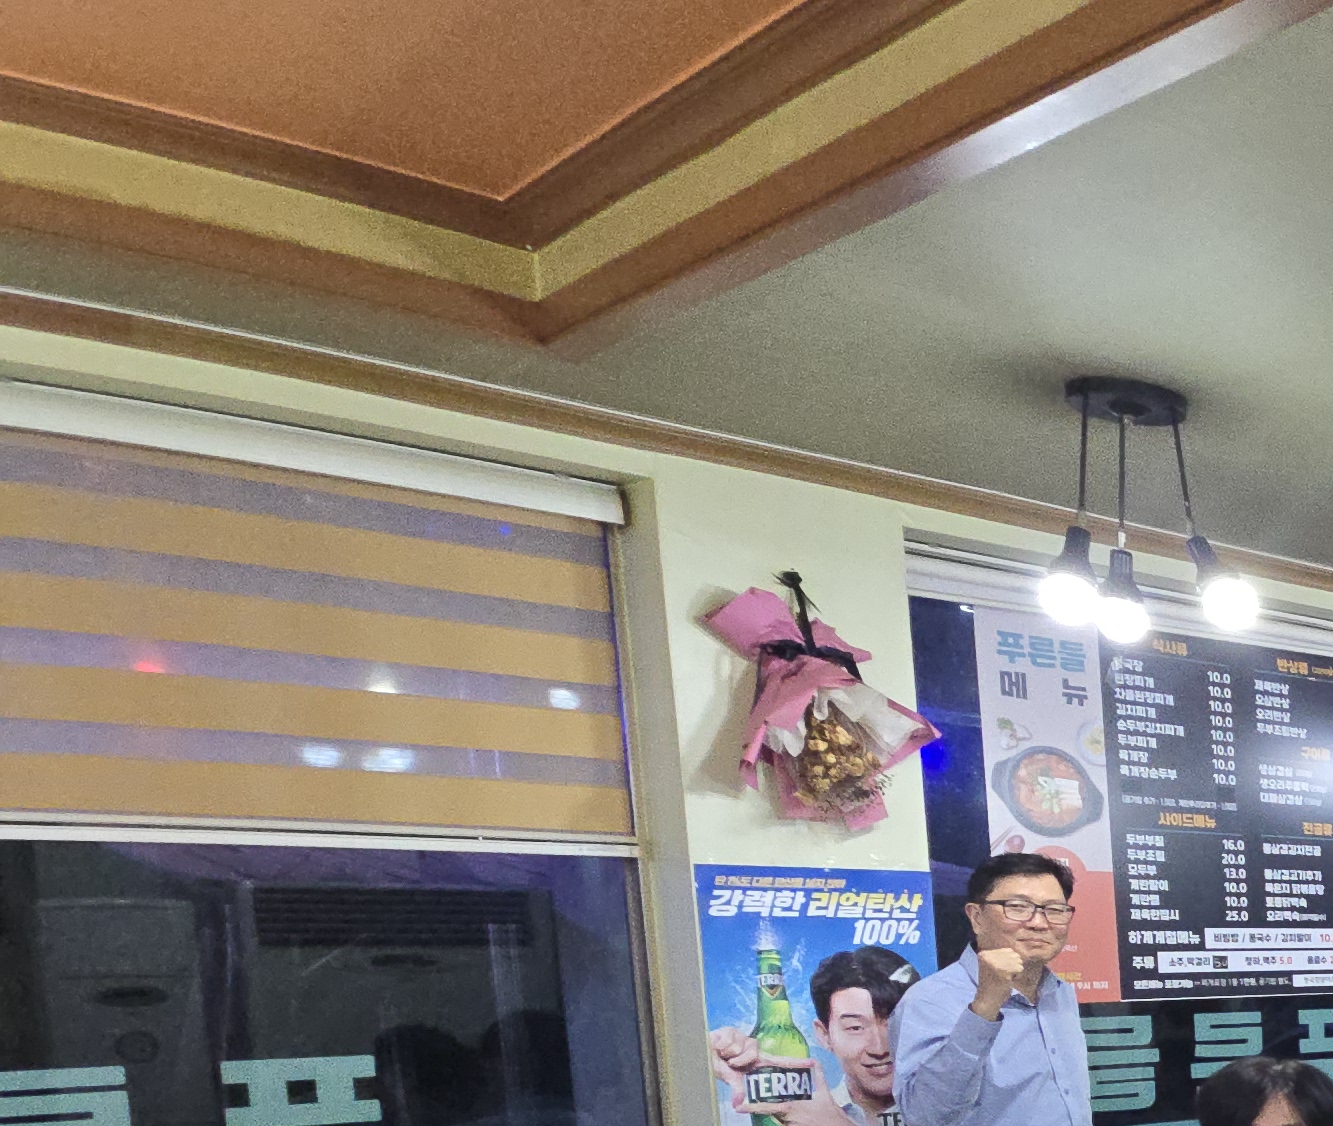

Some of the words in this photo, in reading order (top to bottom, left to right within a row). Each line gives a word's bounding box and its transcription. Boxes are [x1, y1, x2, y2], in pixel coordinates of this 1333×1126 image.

[996, 630, 1087, 673] 푸른들
[1207, 670, 1230, 684] 10.0
[1208, 685, 1231, 699] 10.0
[1208, 700, 1231, 714] 10.0
[1210, 715, 1232, 728] 10.0
[1211, 729, 1233, 742] 10.0
[1211, 744, 1234, 757] 10.0
[1212, 758, 1235, 771] 10.0
[1213, 773, 1236, 786] 10.0
[1158, 812, 1216, 829] 사이드메뉴
[1222, 839, 1246, 851] 16.0
[1221, 853, 1246, 866] 20.0
[1223, 868, 1247, 880] 13.0
[1223, 882, 1248, 894] 10.0
[707, 889, 807, 918] 강력한
[806, 889, 924, 920] 리얼탄산
[1224, 896, 1249, 908] 10.0
[1225, 910, 1249, 922] 25.0
[852, 919, 922, 946] 100%
[1279, 956, 1293, 965] 5.0
[747, 1069, 813, 1102] TERRA
